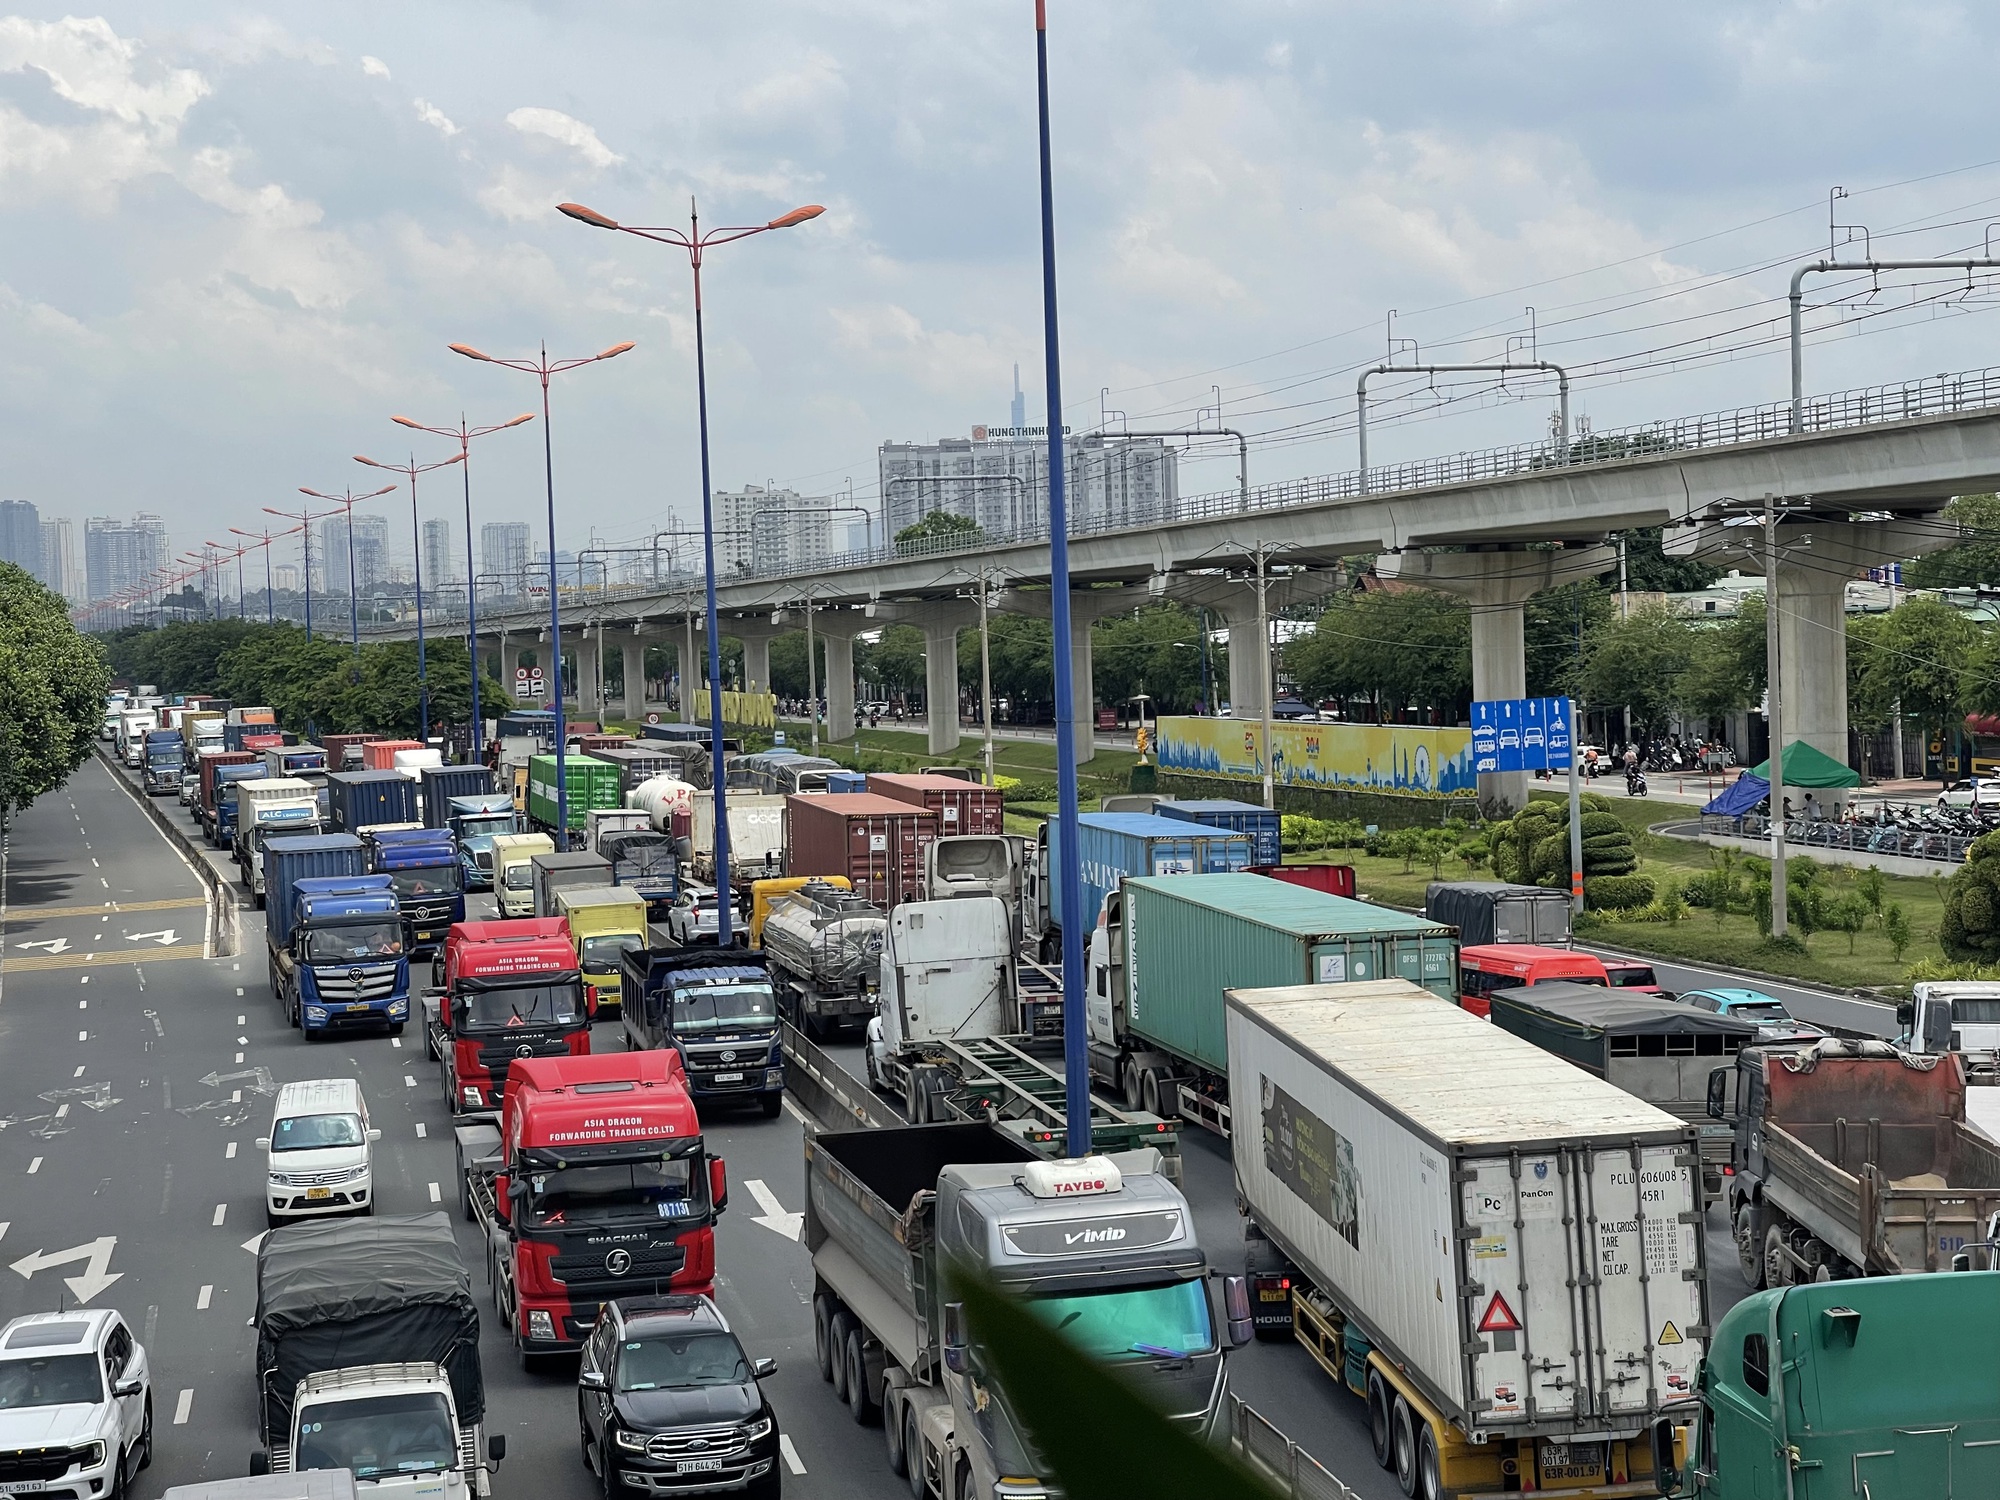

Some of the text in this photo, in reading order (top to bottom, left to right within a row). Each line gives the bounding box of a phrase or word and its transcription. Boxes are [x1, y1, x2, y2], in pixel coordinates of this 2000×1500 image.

[988, 427, 1015, 437] HUNG
[1014, 426, 1045, 436] THINH
[662, 788, 691, 806] LP
[262, 811, 282, 819] ALC
[498, 956, 539, 965] ASIA DRAGON
[475, 964, 514, 973] FORWARDING
[515, 963, 542, 971] TRADING
[584, 1117, 643, 1128] ASIA DRAGON
[549, 1130, 606, 1142] FORWARDING
[609, 1128, 646, 1137] TRADING
[1610, 1169, 1687, 1185] PCLU 606008 5
[1641, 1189, 1665, 1202] 45R1
[1484, 1197, 1501, 1210] PC
[587, 1233, 648, 1245] SHACMAN
[1601, 1236, 1619, 1248] TARE
[1602, 1250, 1615, 1262] NET
[1255, 1315, 1293, 1324] HOWO
[1547, 1447, 1562, 1456] 63R
[1542, 1454, 1569, 1466] 001.97
[1544, 1465, 1600, 1480] 63R-001.97
